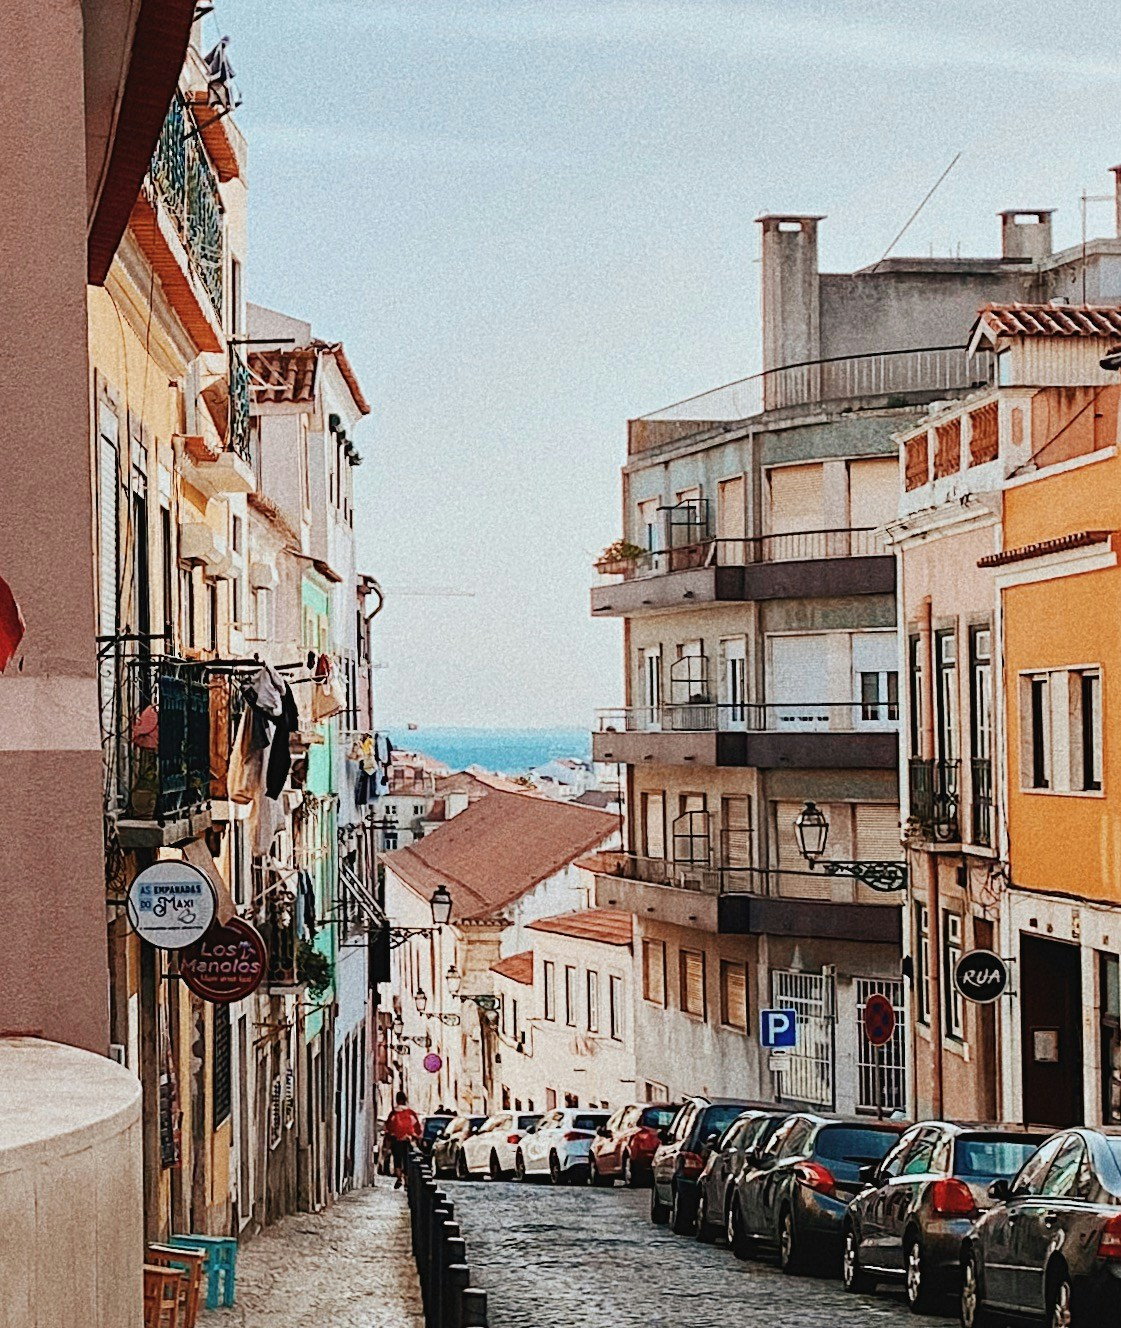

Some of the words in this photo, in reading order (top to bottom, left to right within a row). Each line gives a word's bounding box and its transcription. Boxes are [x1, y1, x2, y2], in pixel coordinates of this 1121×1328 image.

[140, 885, 151, 894] AS
[153, 884, 202, 895] EMPANADAS
[201, 941, 237, 957] Los
[181, 956, 261, 973] Manolos
[962, 968, 1001, 987] RUA
[768, 1013, 790, 1045] P
